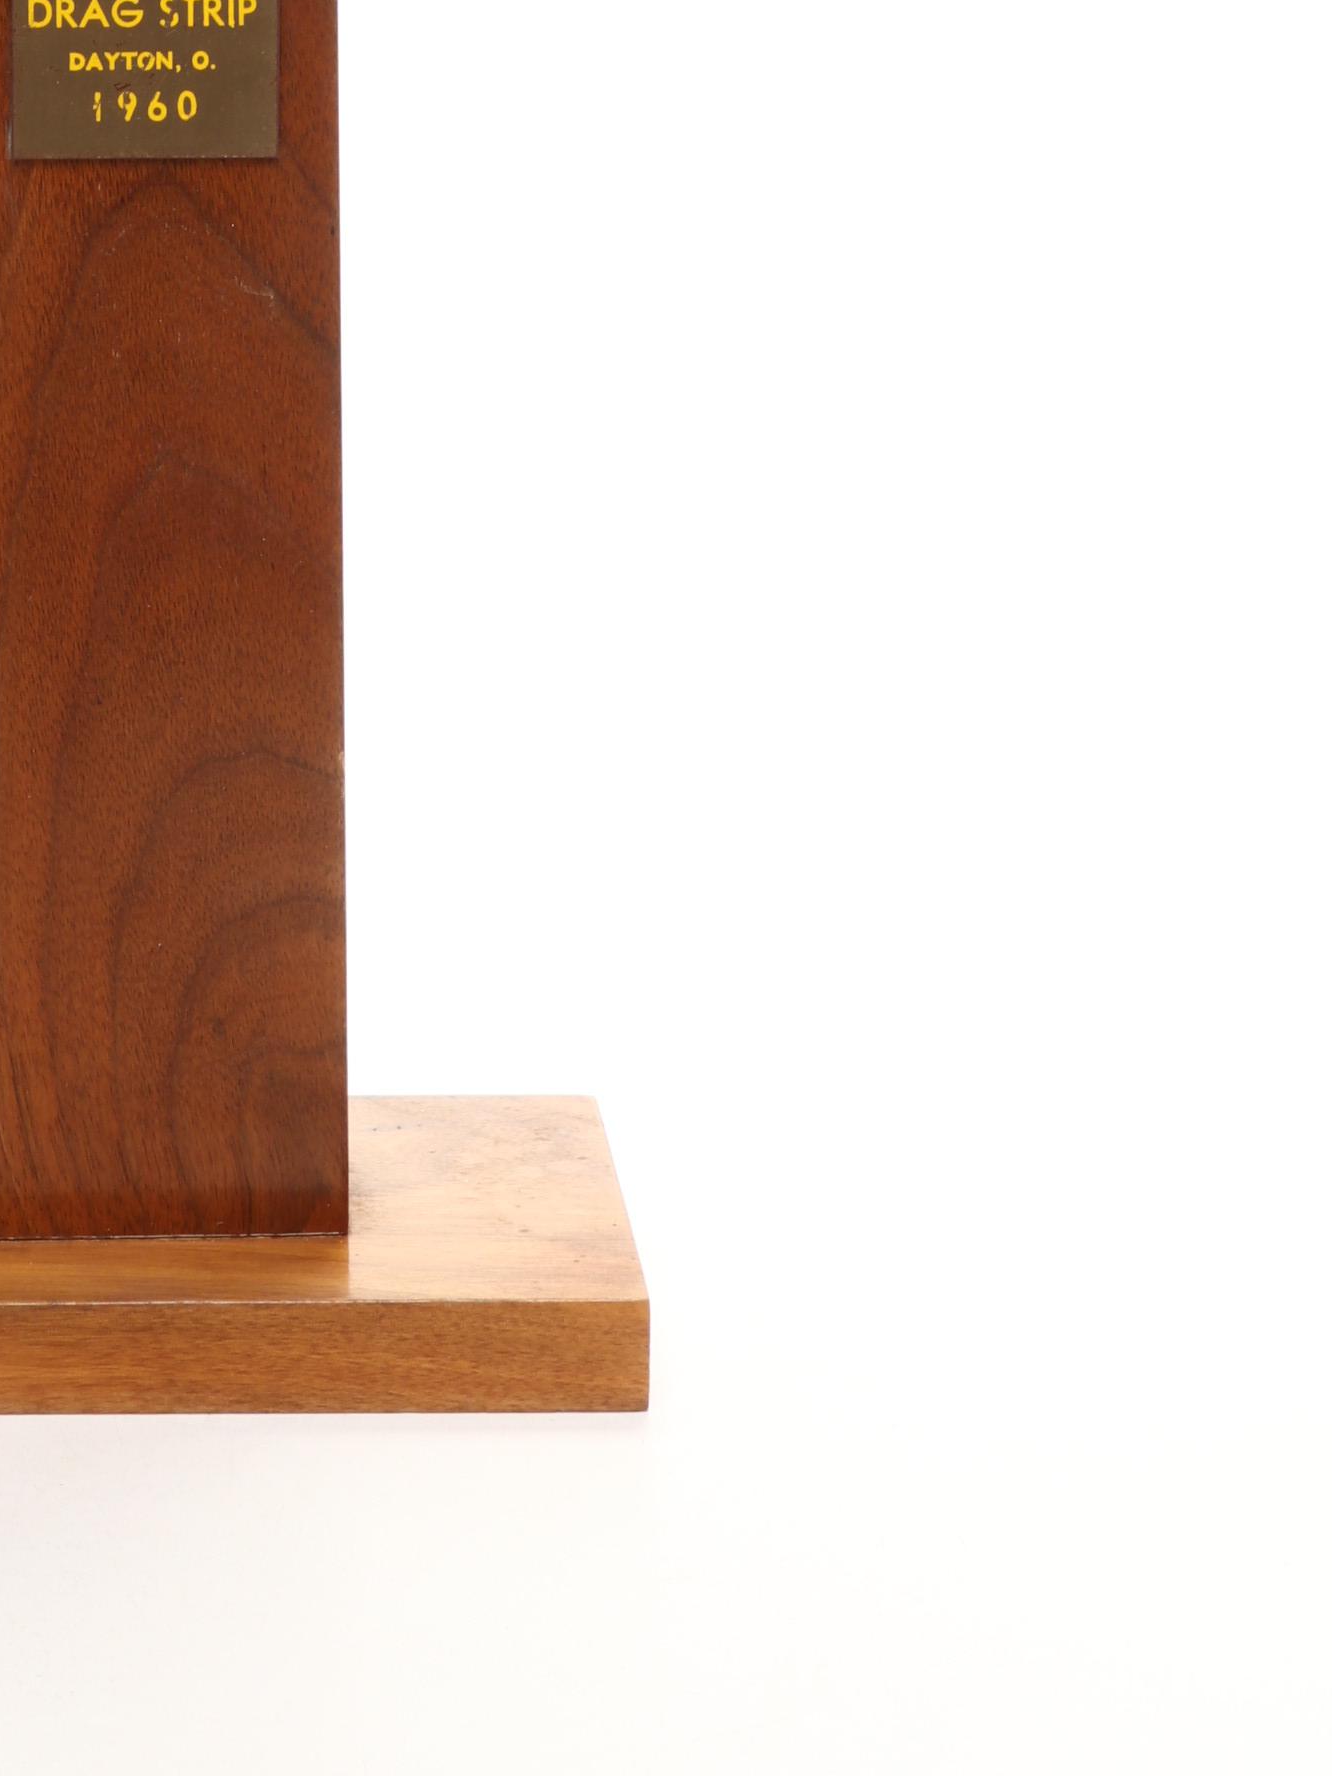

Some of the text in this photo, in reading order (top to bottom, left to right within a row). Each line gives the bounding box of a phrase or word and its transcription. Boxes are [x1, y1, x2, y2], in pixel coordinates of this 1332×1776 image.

[68, 50, 217, 74] DAYTON, O.
[92, 89, 199, 123] 1960
